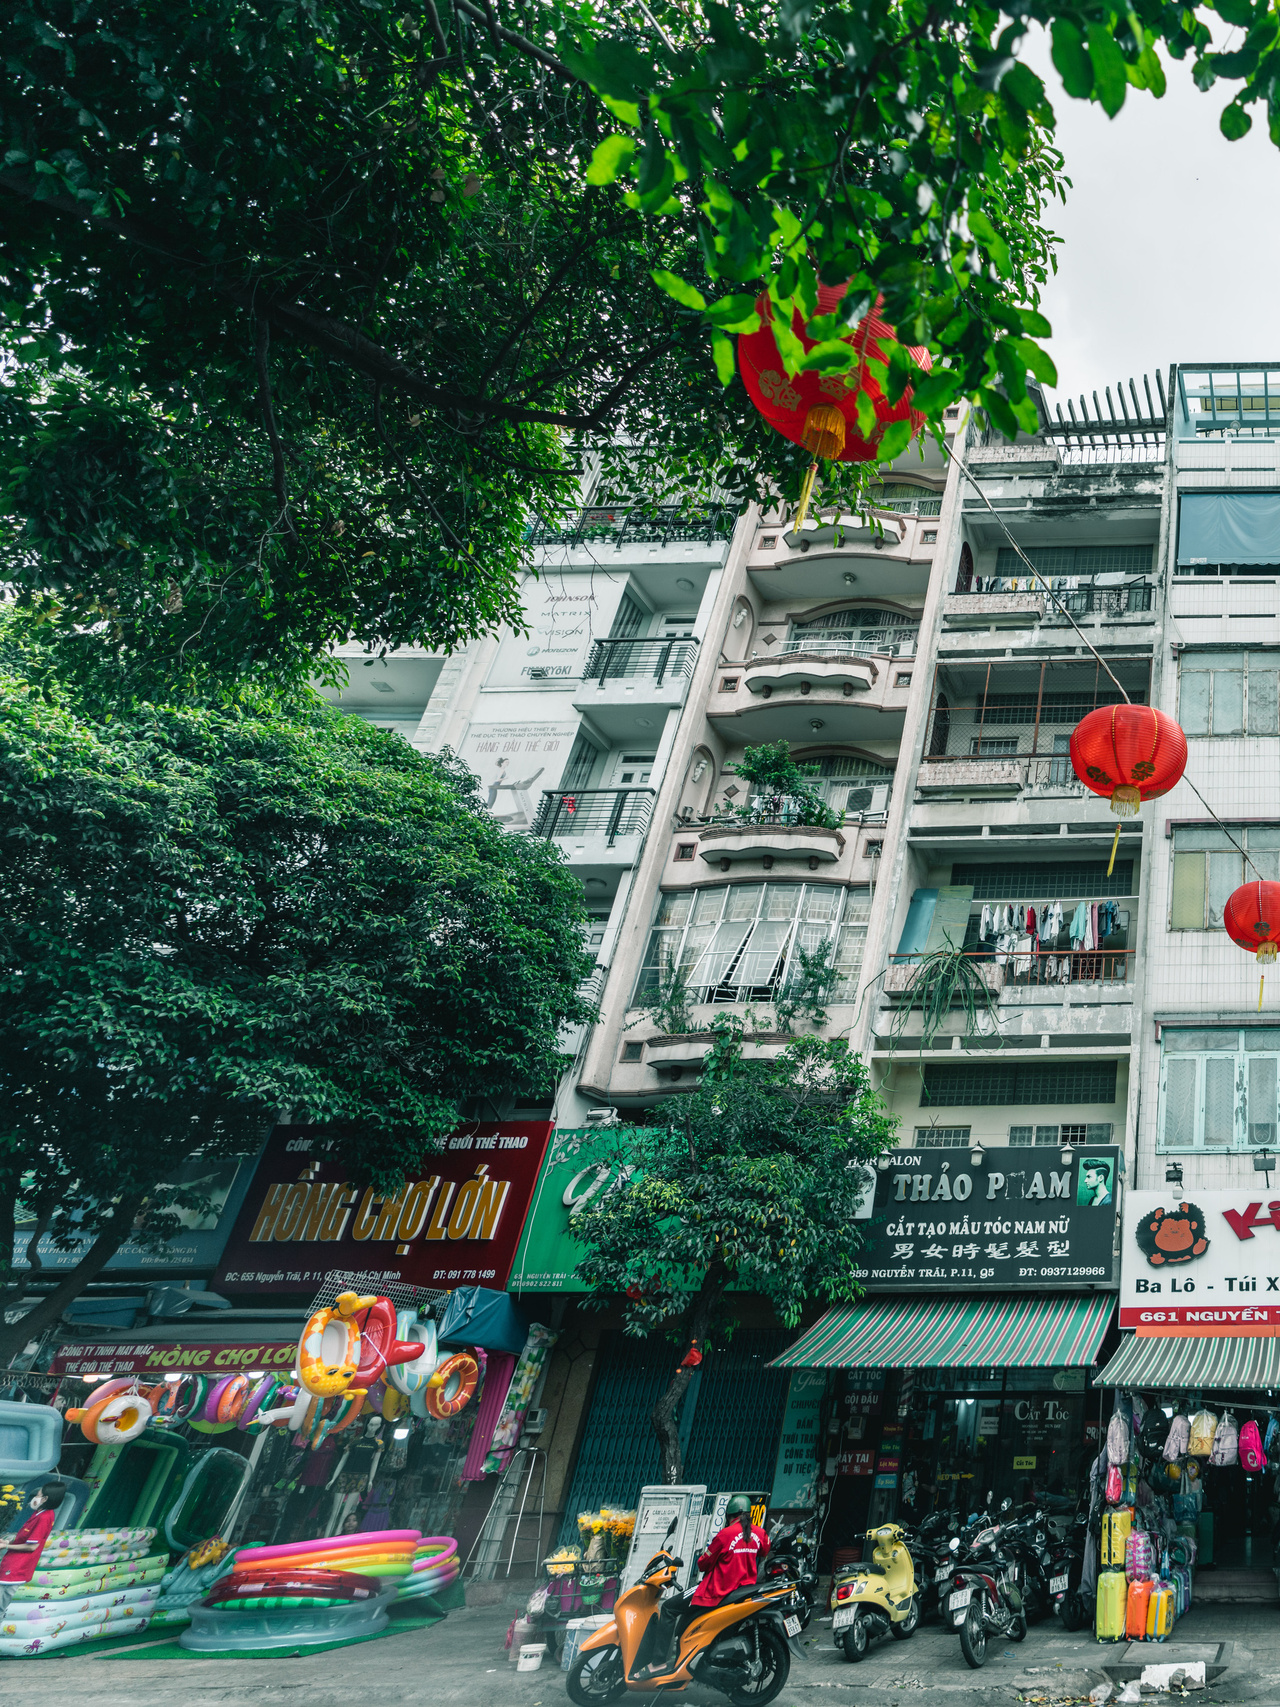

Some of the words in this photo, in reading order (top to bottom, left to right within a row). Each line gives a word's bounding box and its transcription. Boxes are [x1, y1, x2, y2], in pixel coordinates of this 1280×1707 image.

[285, 1137, 314, 1151] CÔN
[448, 1134, 475, 1150] GIỚI
[474, 1132, 500, 1150] THỂ
[499, 1135, 529, 1149] THAO
[884, 1155, 923, 1167] ALON
[892, 1161, 974, 1202] THẢO
[985, 1170, 1072, 1200] PAM
[249, 1161, 358, 1242] HỒNG
[352, 1175, 441, 1256] CHỢ
[426, 1163, 512, 1241] LỚN
[886, 1215, 916, 1237] CẮT
[917, 1221, 947, 1239] TẠO
[948, 1214, 982, 1236] MẪU
[983, 1216, 1012, 1235] TÓC
[1013, 1220, 1047, 1235] NAM
[1047, 1215, 1071, 1235] NỮ
[240, 1271, 255, 1282] 655
[255, 1270, 286, 1284] Nguyễn
[433, 1270, 447, 1280] ĐT:
[447, 1270, 463, 1280] 091
[463, 1270, 477, 1280] 778
[476, 1269, 496, 1280] 1499
[870, 1264, 916, 1279] NGUYỄN
[950, 1268, 977, 1279] P.11,
[979, 1267, 995, 1280] Q5
[1018, 1267, 1038, 1277] ĐT:
[1040, 1266, 1106, 1277] 0937129966
[1135, 1278, 1162, 1294] Ba
[1170, 1277, 1196, 1293] Lô
[1224, 1275, 1257, 1292] Túi
[1139, 1311, 1179, 1323] 661
[1185, 1306, 1269, 1322] NGUYỄN
[59, 1345, 83, 1357] CÔNG
[83, 1345, 98, 1357] TY
[97, 1345, 116, 1356] TNHH
[115, 1345, 136, 1356] MAY
[145, 1343, 210, 1367] HỒNG
[213, 1345, 261, 1371] CHỢ
[114, 1360, 135, 1372] THAO
[855, 1453, 870, 1463] TAI
